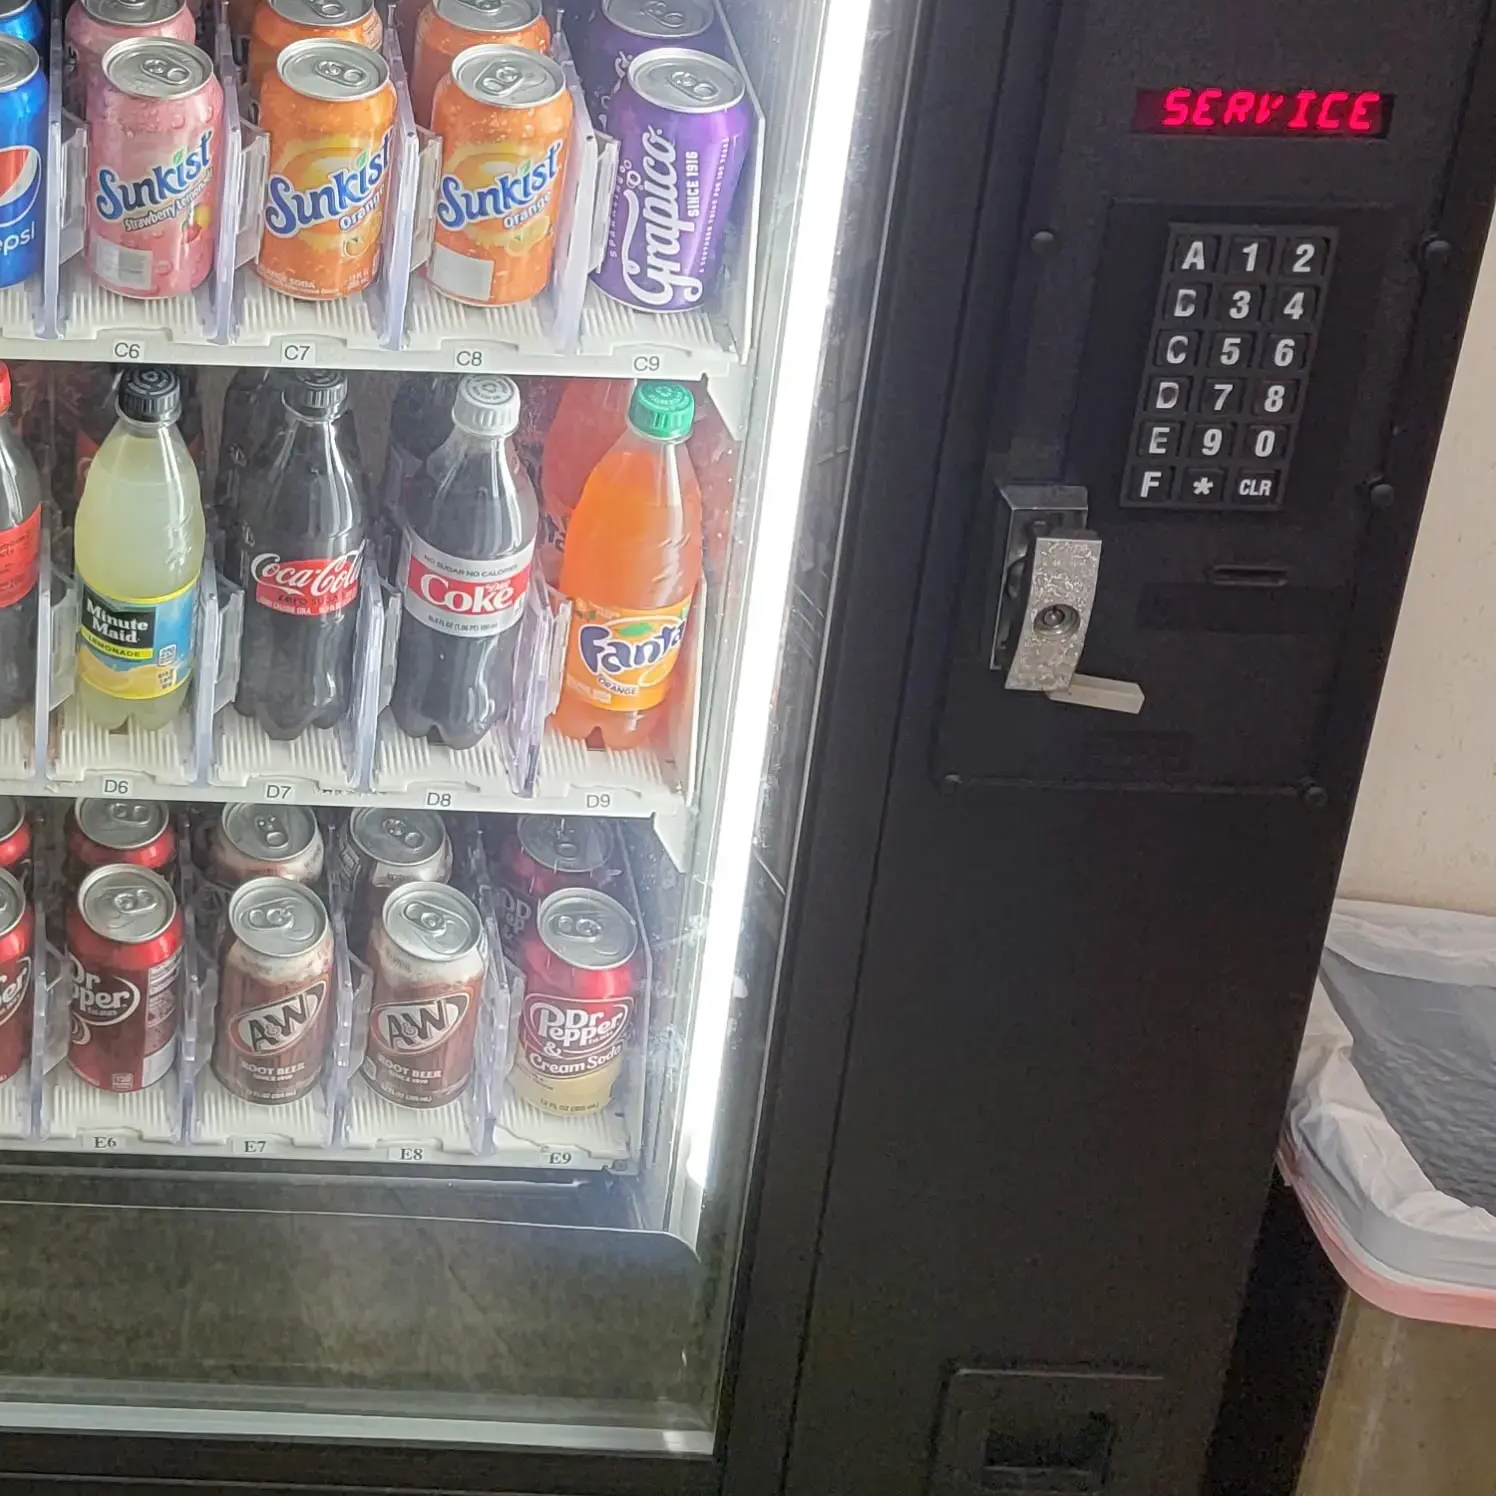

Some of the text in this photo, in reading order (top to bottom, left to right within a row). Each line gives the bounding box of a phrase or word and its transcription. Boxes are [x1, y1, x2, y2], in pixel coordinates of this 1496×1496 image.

[1162, 87, 1380, 130] SERVICE
[97, 130, 213, 221] Sunkist
[266, 125, 394, 238] Sunkist
[436, 139, 563, 231] Sunkist
[685, 151, 700, 218] SINCE 1916
[124, 206, 177, 232] Strawberry
[622, 125, 703, 305] Grapico
[1181, 241, 1315, 272] A 1 2
[1229, 290, 1304, 320] 3 4
[114, 343, 140, 359] C6
[284, 345, 310, 361] C7
[456, 351, 482, 366] C8
[1166, 335, 1296, 366] C 5 6
[633, 357, 660, 372] C9
[1156, 382, 1285, 412] D 7 8
[1149, 427, 1276, 457] E 9 0
[1140, 471, 1272, 498] F CLR
[421, 573, 514, 613] Coke
[86, 598, 148, 631] Minute
[92, 616, 138, 643] Maid
[88, 635, 141, 658] LEMONADE
[580, 620, 686, 674] Fanta
[598, 676, 637, 695] ORANGE
[104, 779, 129, 794] D6
[266, 785, 292, 800] D7
[426, 792, 452, 807] D8
[587, 794, 611, 808] D9
[248, 993, 314, 1052] A&W
[387, 999, 449, 1050] A&W
[530, 1002, 624, 1047] Pepper
[566, 1009, 605, 1028] Dr
[529, 1045, 622, 1073] Cream Soda
[94, 1136, 117, 1148] E6
[244, 1141, 267, 1152] E7
[400, 1148, 423, 1161] E8
[549, 1152, 572, 1164] E9
